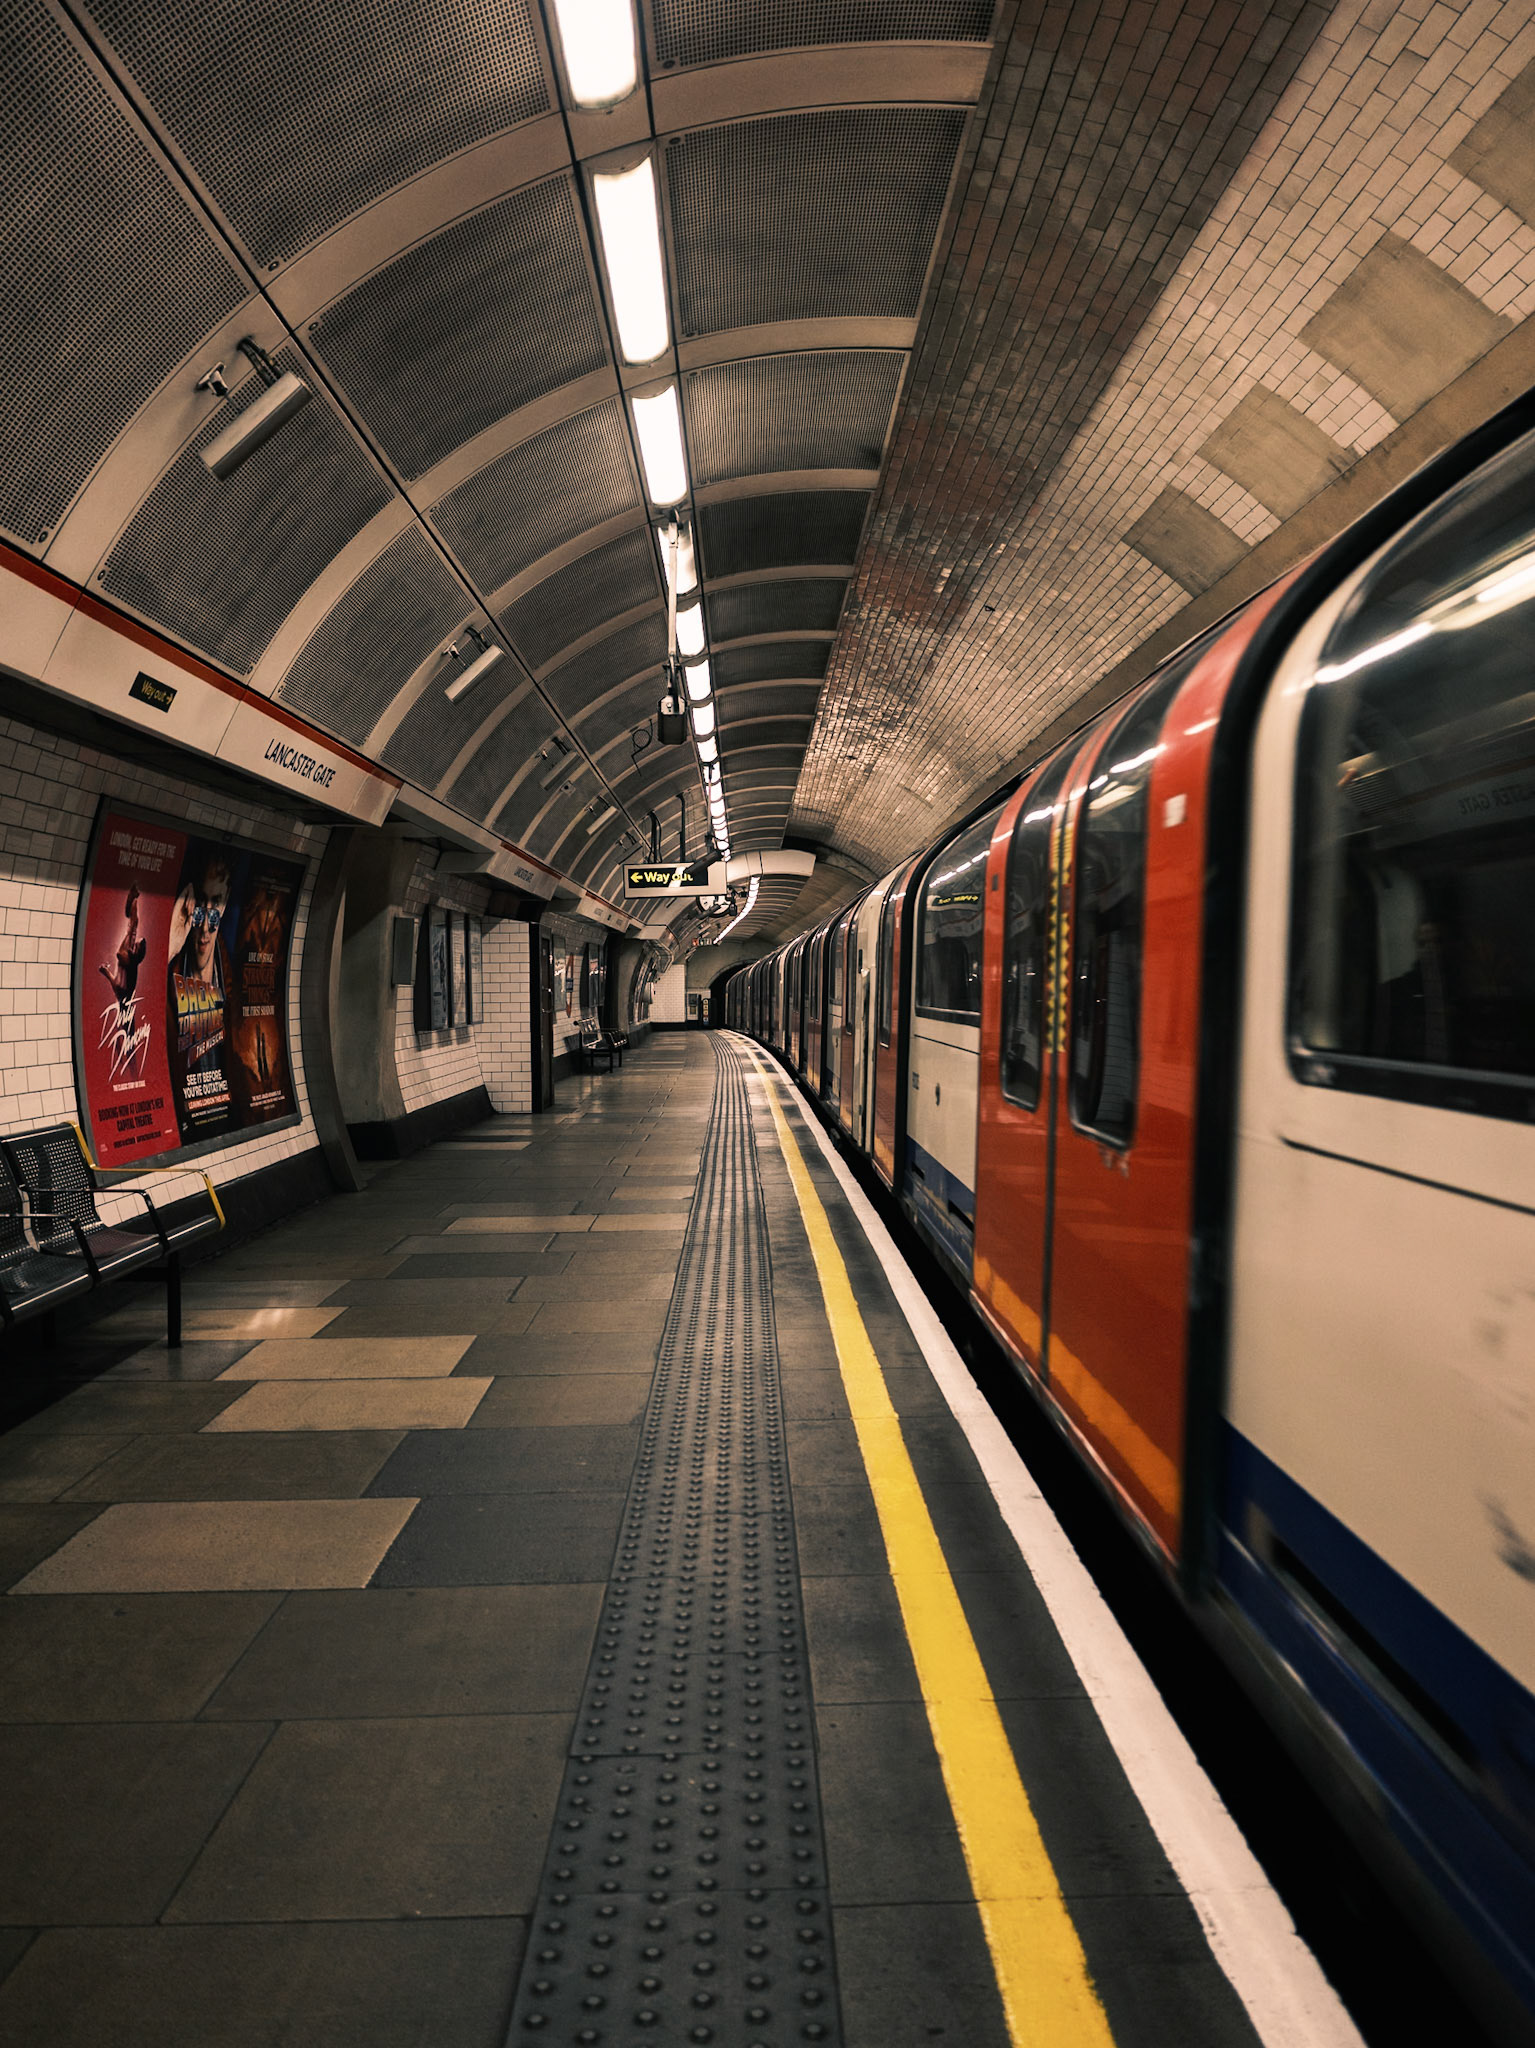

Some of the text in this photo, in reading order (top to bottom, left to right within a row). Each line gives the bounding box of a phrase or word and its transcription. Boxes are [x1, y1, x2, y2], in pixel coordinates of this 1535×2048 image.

[141, 680, 167, 704] Way out
[264, 738, 336, 788] LANCASTER GATE
[644, 871, 670, 885] Way
[173, 973, 216, 1014] BACK
[98, 990, 144, 1050] Dirty
[178, 1008, 225, 1044] TO FUTURE
[108, 1014, 152, 1083] Dancing
[196, 1029, 225, 1059] THE MUSICAL
[183, 1084, 203, 1099] YOU'RE
[186, 1069, 222, 1086] SEE IT BEFORE
[134, 1113, 153, 1129] THEATRE
